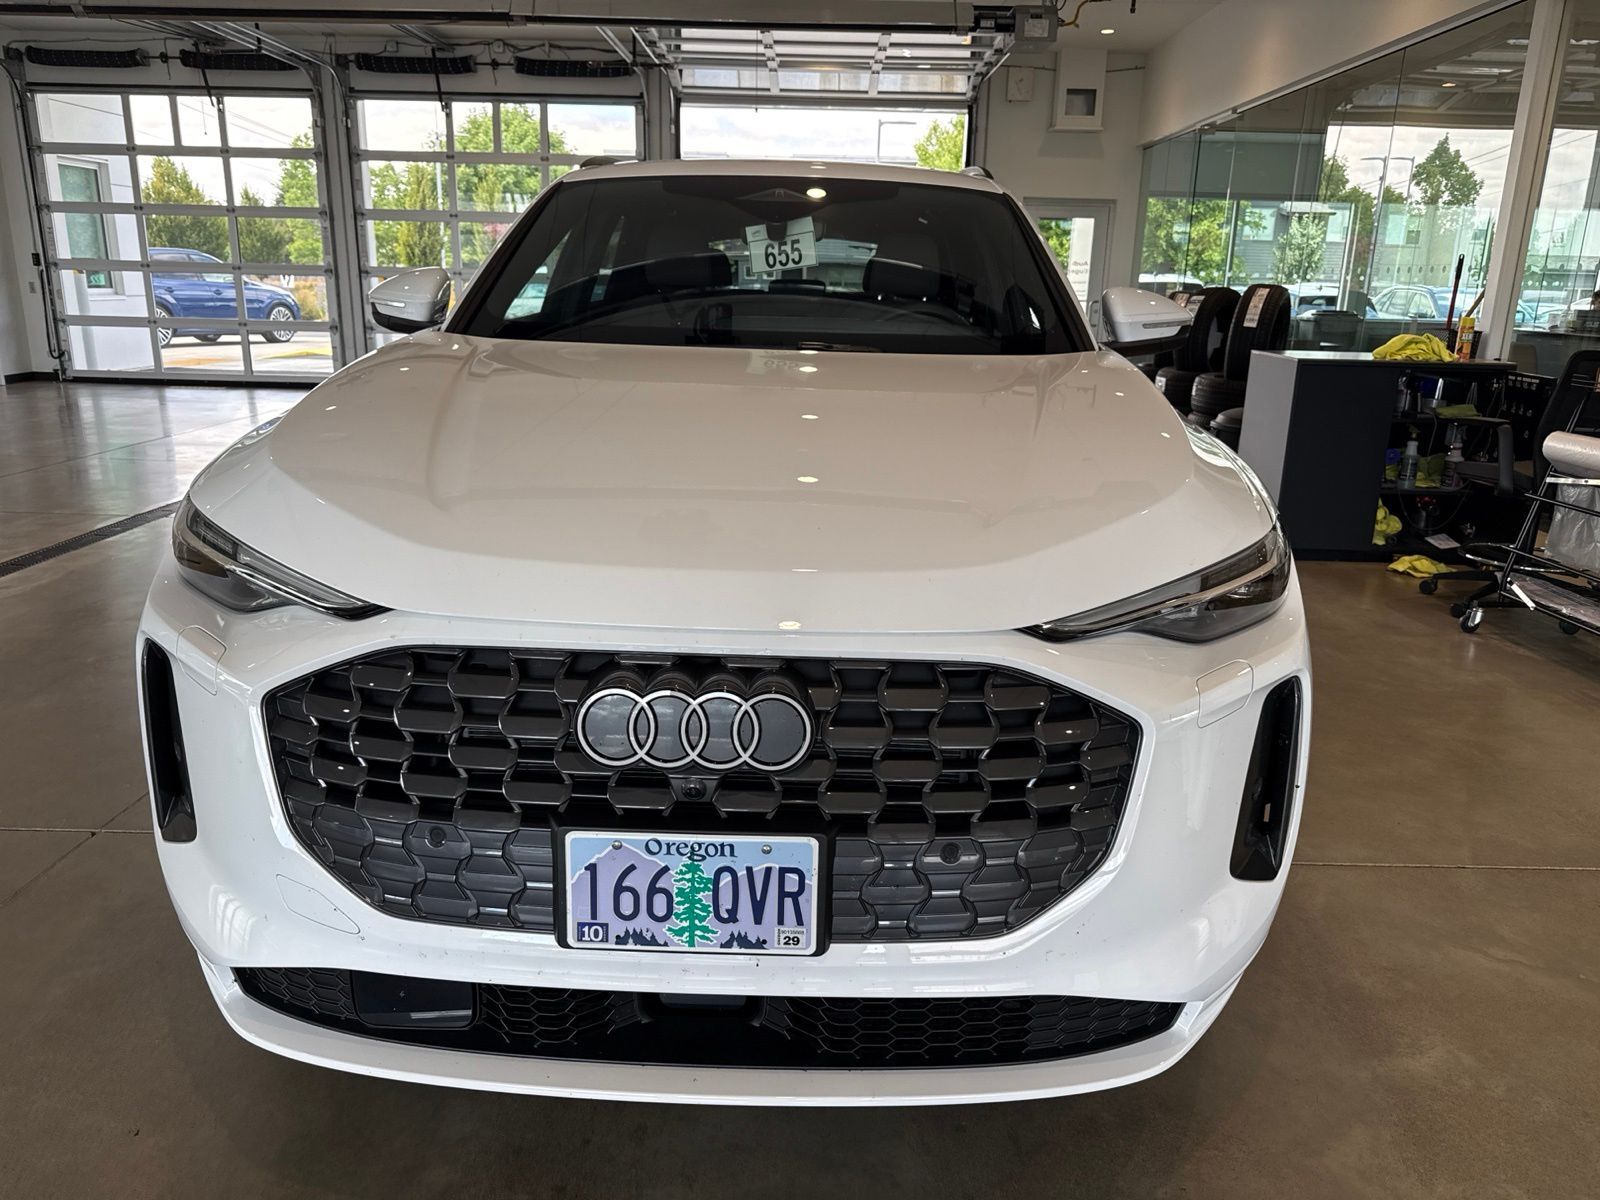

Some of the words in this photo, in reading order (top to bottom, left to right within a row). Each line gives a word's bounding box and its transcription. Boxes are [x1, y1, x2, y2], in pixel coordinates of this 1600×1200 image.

[764, 238, 803, 269] 655
[644, 838, 738, 862] Oregon
[584, 862, 674, 923] 166
[712, 865, 806, 927] QVR
[581, 925, 603, 942] 10
[783, 935, 800, 946] 29
